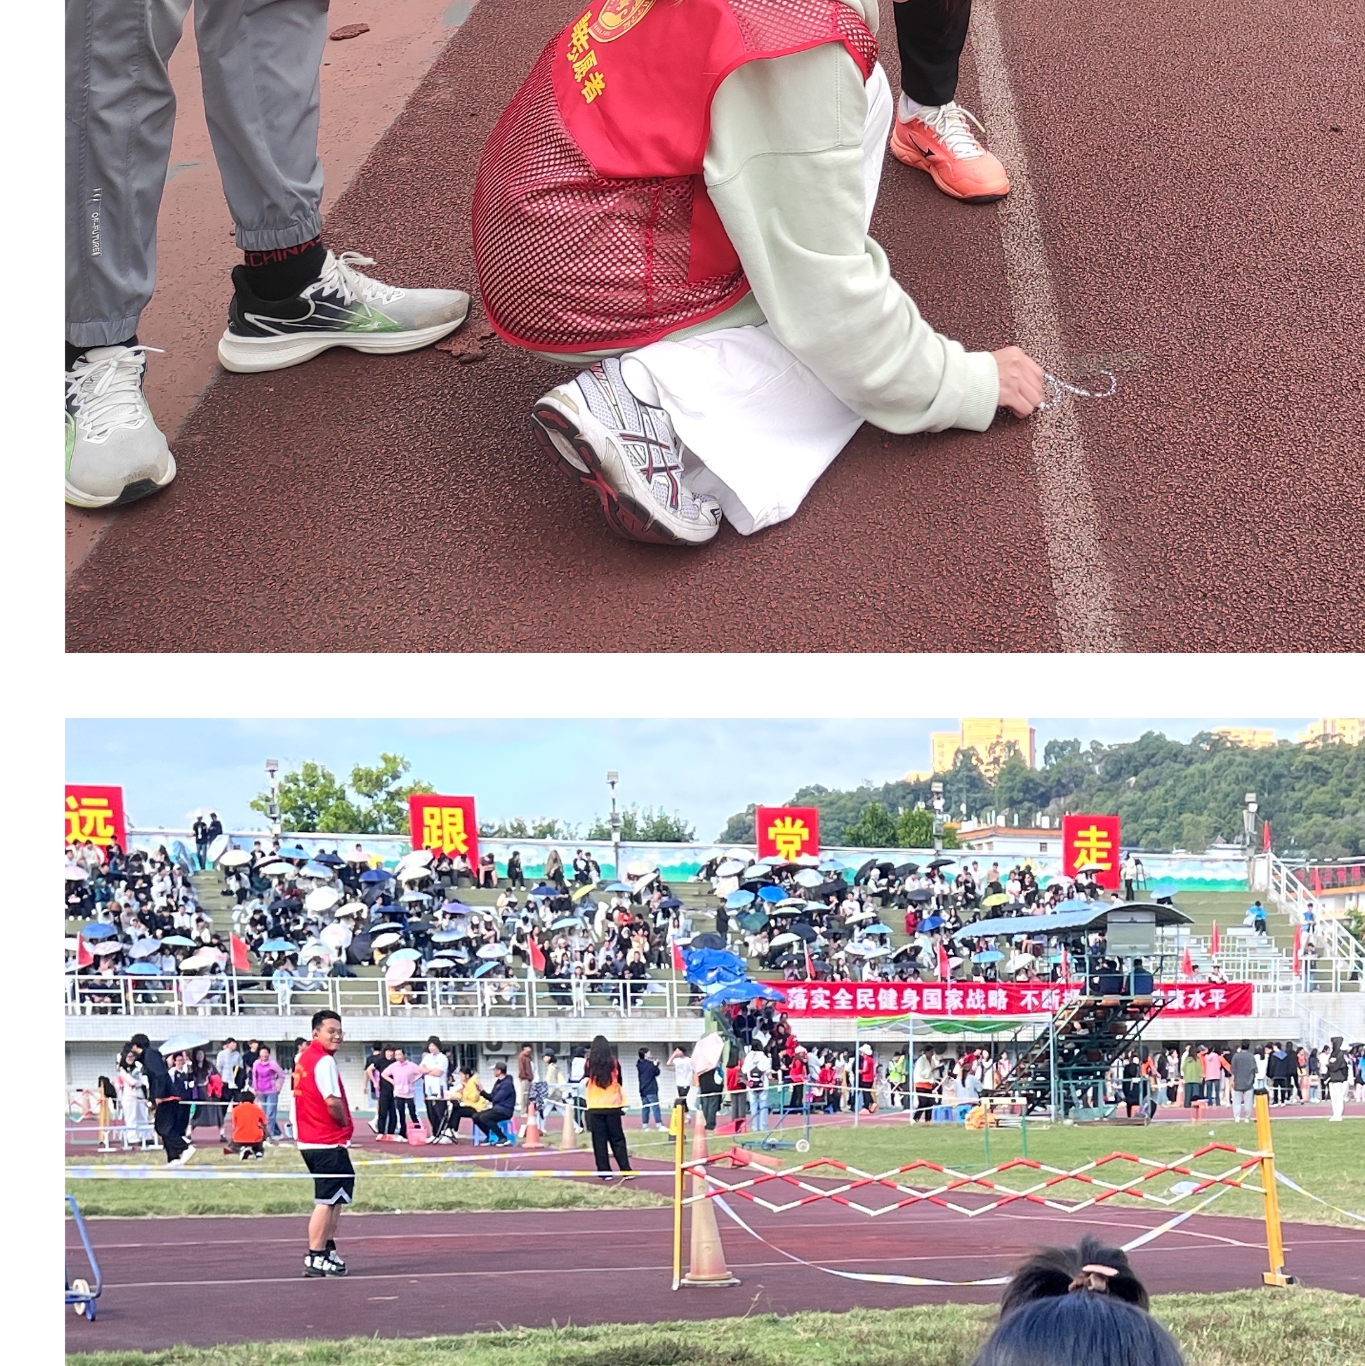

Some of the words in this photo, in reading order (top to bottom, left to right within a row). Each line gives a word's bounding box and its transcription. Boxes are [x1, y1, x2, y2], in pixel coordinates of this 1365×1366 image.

[65, 795, 115, 847] 远
[422, 806, 469, 855] 跟
[768, 816, 809, 864] 党
[1073, 825, 1113, 871] 走
[787, 988, 1008, 1011] 落实全民健身国家战略
